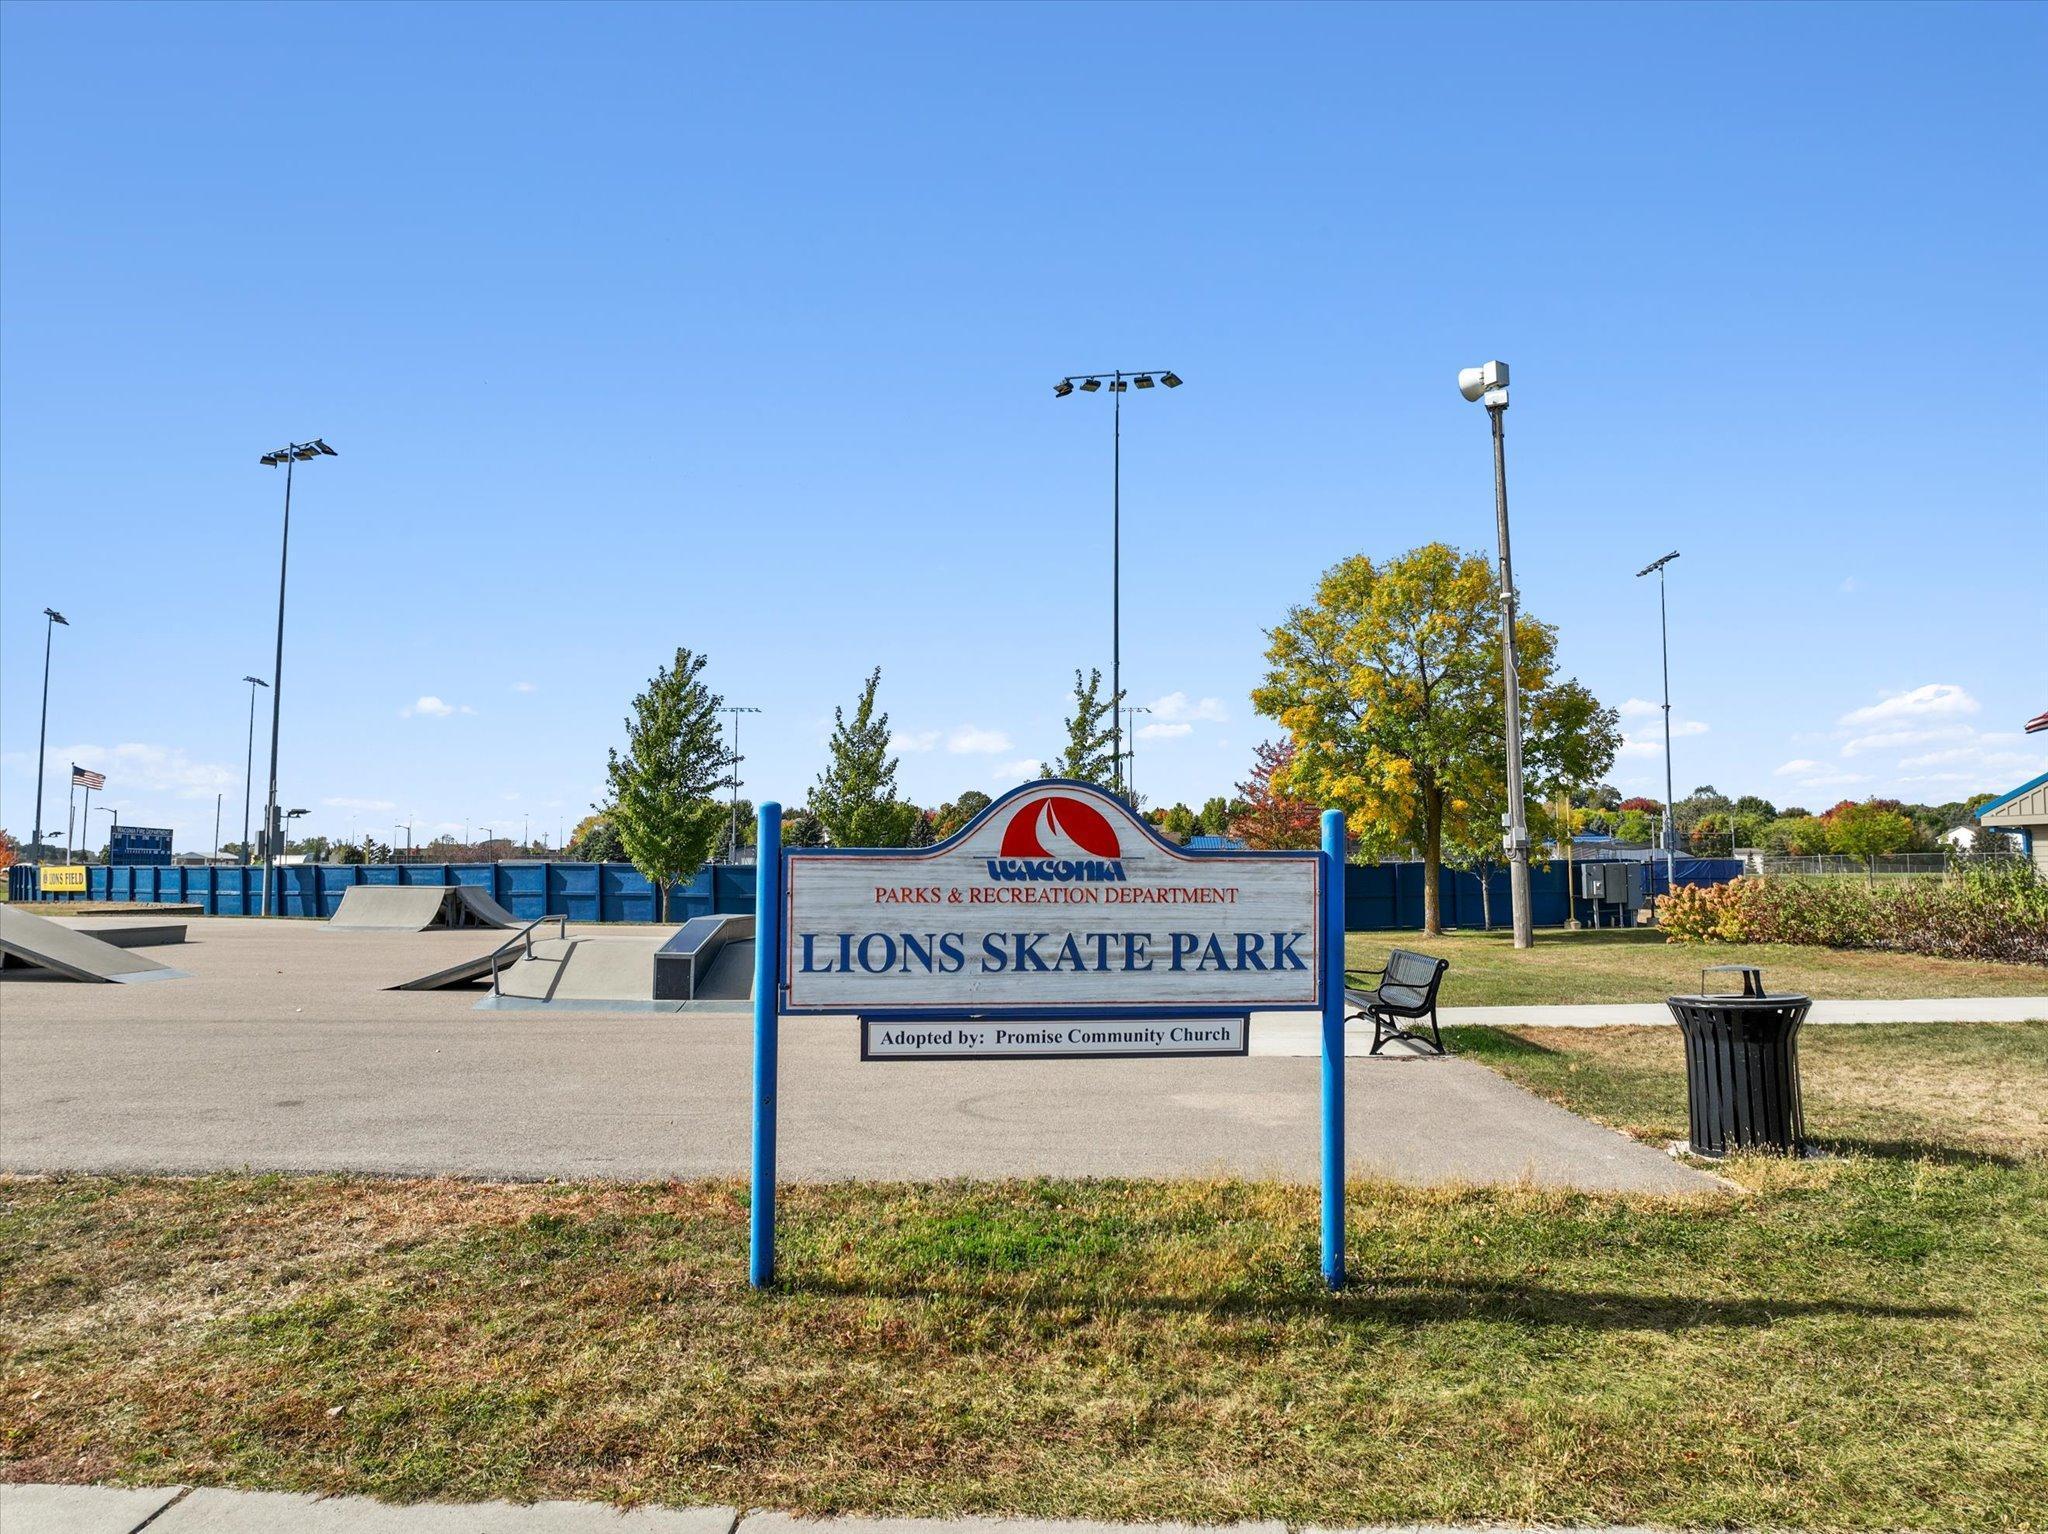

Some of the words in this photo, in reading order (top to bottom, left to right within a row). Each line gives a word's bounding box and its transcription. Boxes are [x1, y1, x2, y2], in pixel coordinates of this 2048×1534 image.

[65, 873, 84, 885] FIELD
[875, 887, 941, 904] PARKS
[948, 887, 963, 904] &
[969, 887, 1098, 904] RECREATION
[1105, 887, 1239, 904] DEPARTMENT
[799, 932, 965, 974] LIONS
[981, 932, 1154, 973] SKATE
[1168, 932, 1308, 972] PARK
[881, 1031, 952, 1048] Adopted
[958, 1031, 984, 1048] by:
[996, 1029, 1063, 1044] Promise
[1067, 1028, 1164, 1046] Community
[1170, 1026, 1230, 1041] Church
